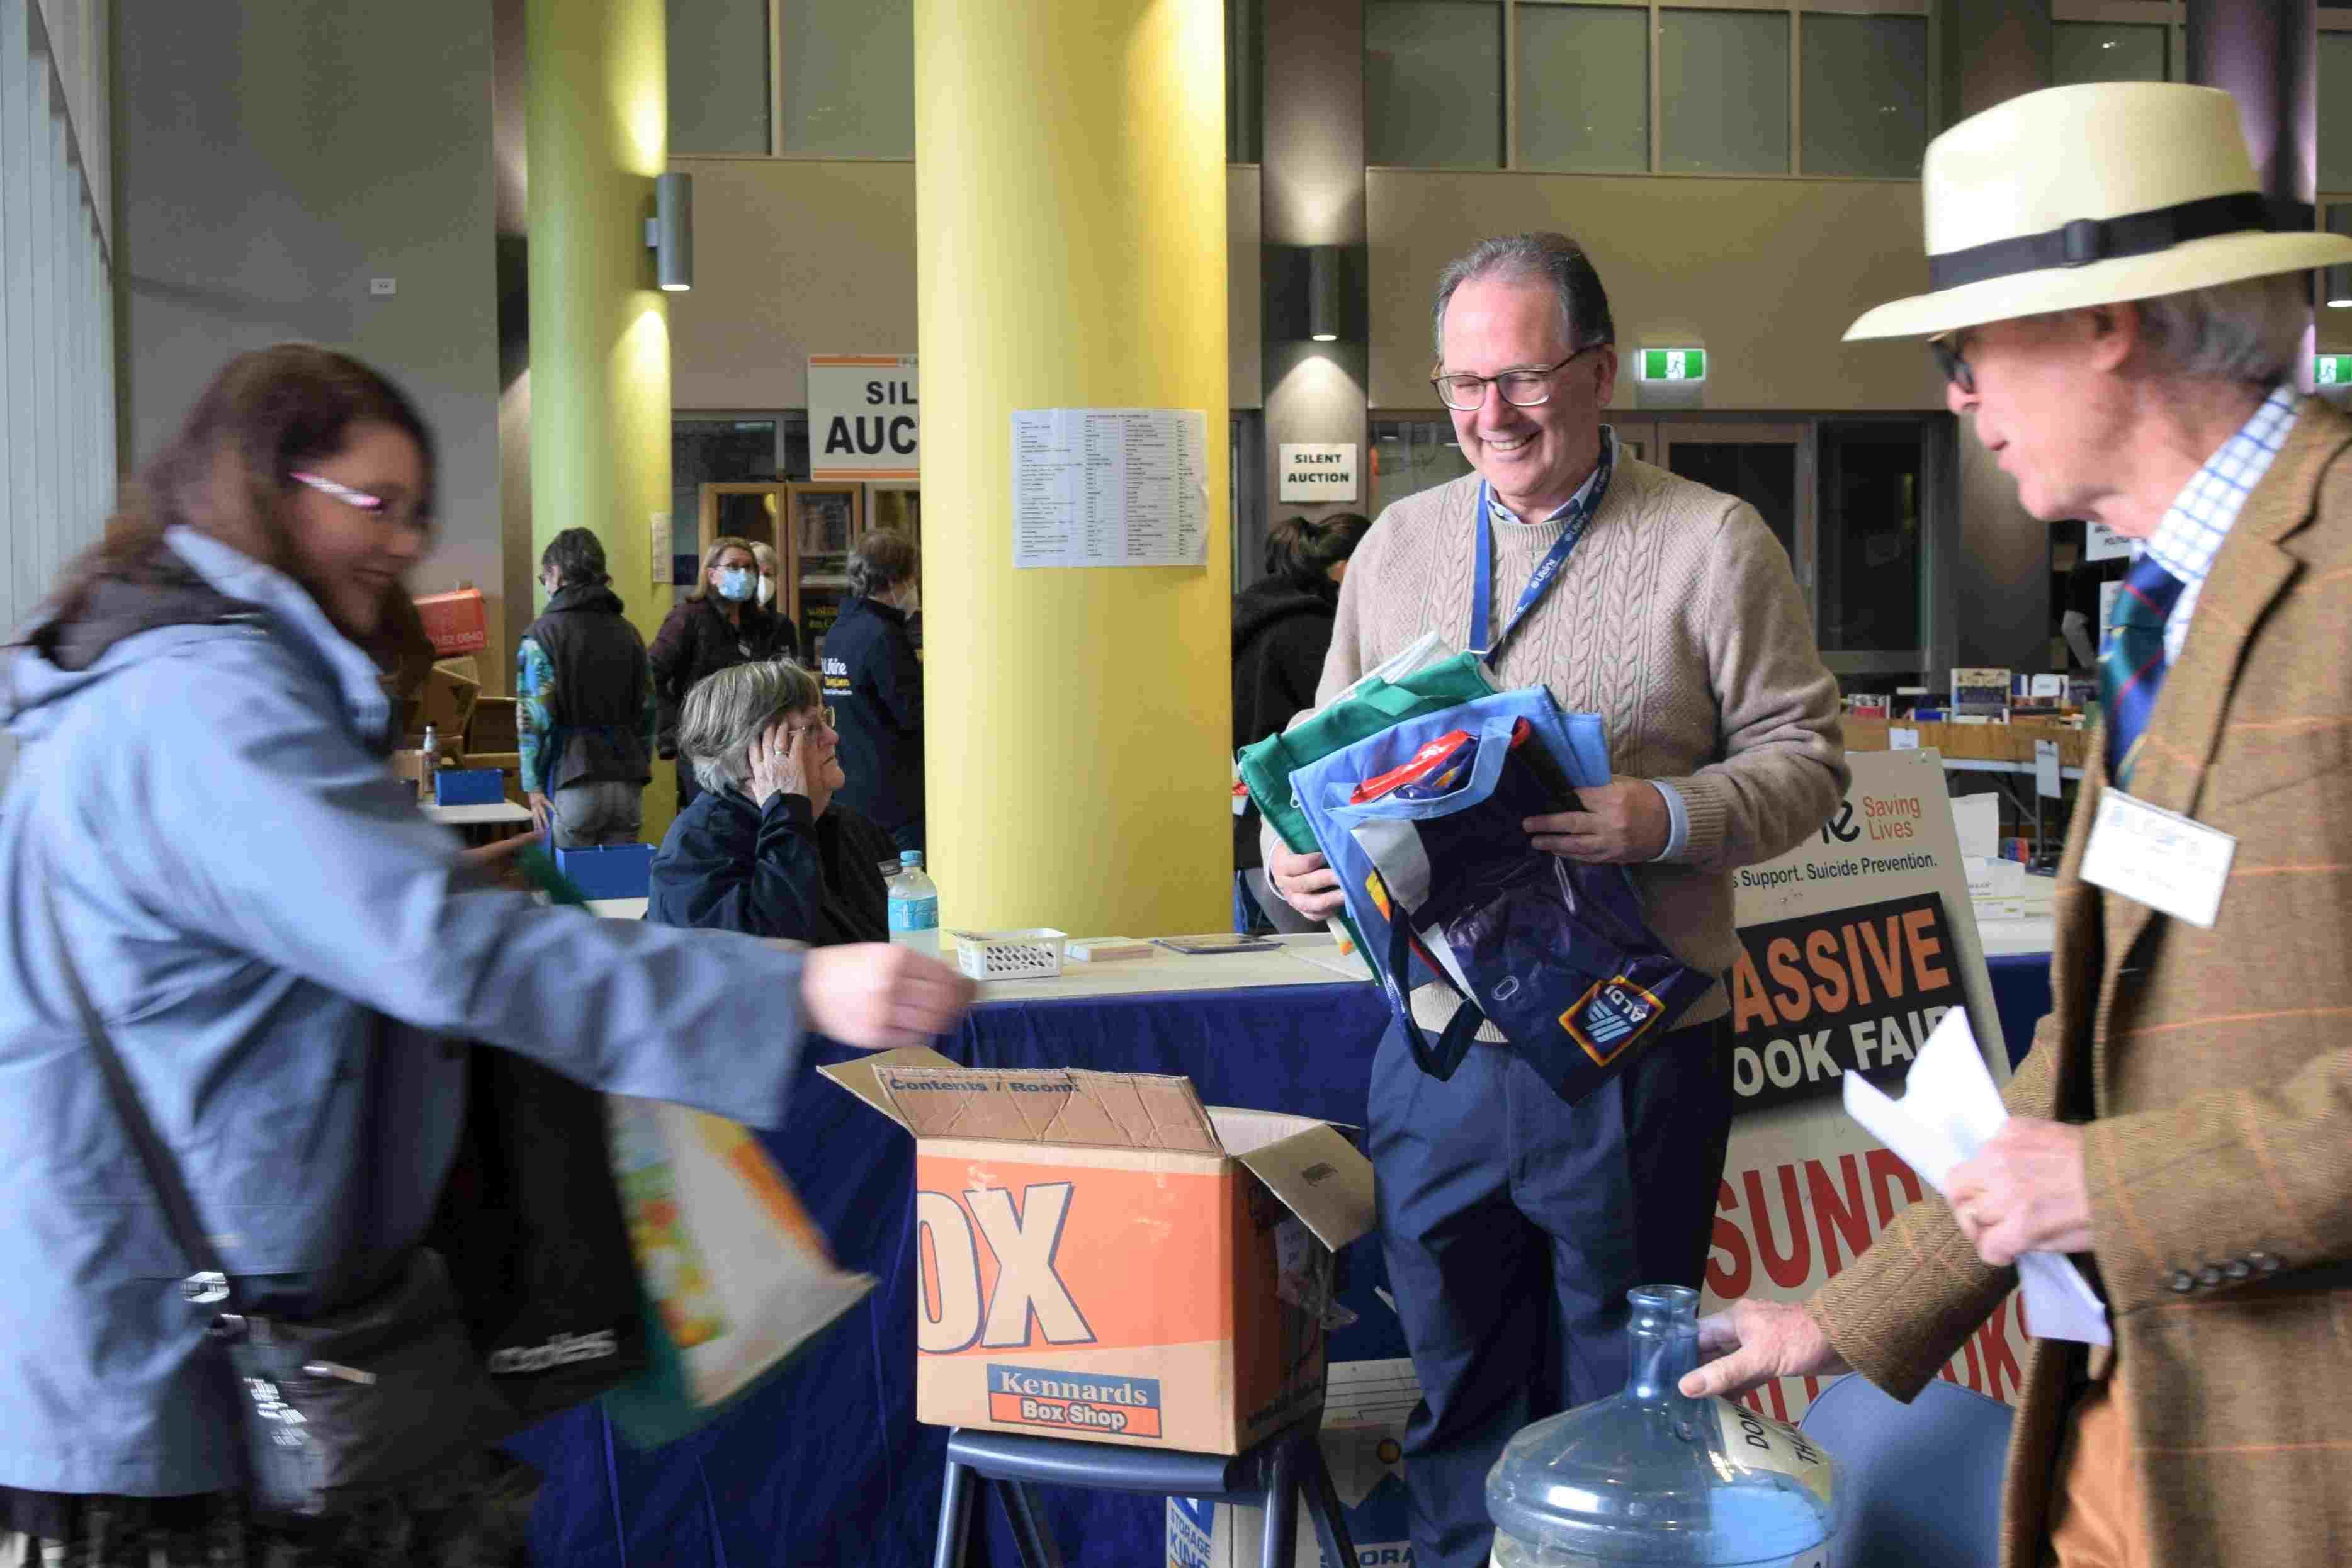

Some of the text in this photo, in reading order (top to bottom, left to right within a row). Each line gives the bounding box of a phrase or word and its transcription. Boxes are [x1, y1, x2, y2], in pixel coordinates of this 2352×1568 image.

[866, 381, 917, 405] SIL
[825, 415, 917, 454] AUC
[1294, 454, 1342, 463] SILENT
[1288, 473, 1349, 483] AUCTION
[1863, 794, 1921, 819] Saving
[1868, 819, 1914, 841] Lives
[1741, 865, 1804, 889] Support.
[1806, 859, 1858, 880] Suicide
[1860, 852, 1938, 874] Prevention.
[1733, 908, 1951, 1033] ASSIVE
[1604, 985, 1651, 1022] ALDI
[890, 1077, 988, 1091] Contents
[1009, 1081, 1080, 1093] Room:
[1000, 1370, 1149, 1406] Kennards
[1021, 1398, 1127, 1431] Box Shop
